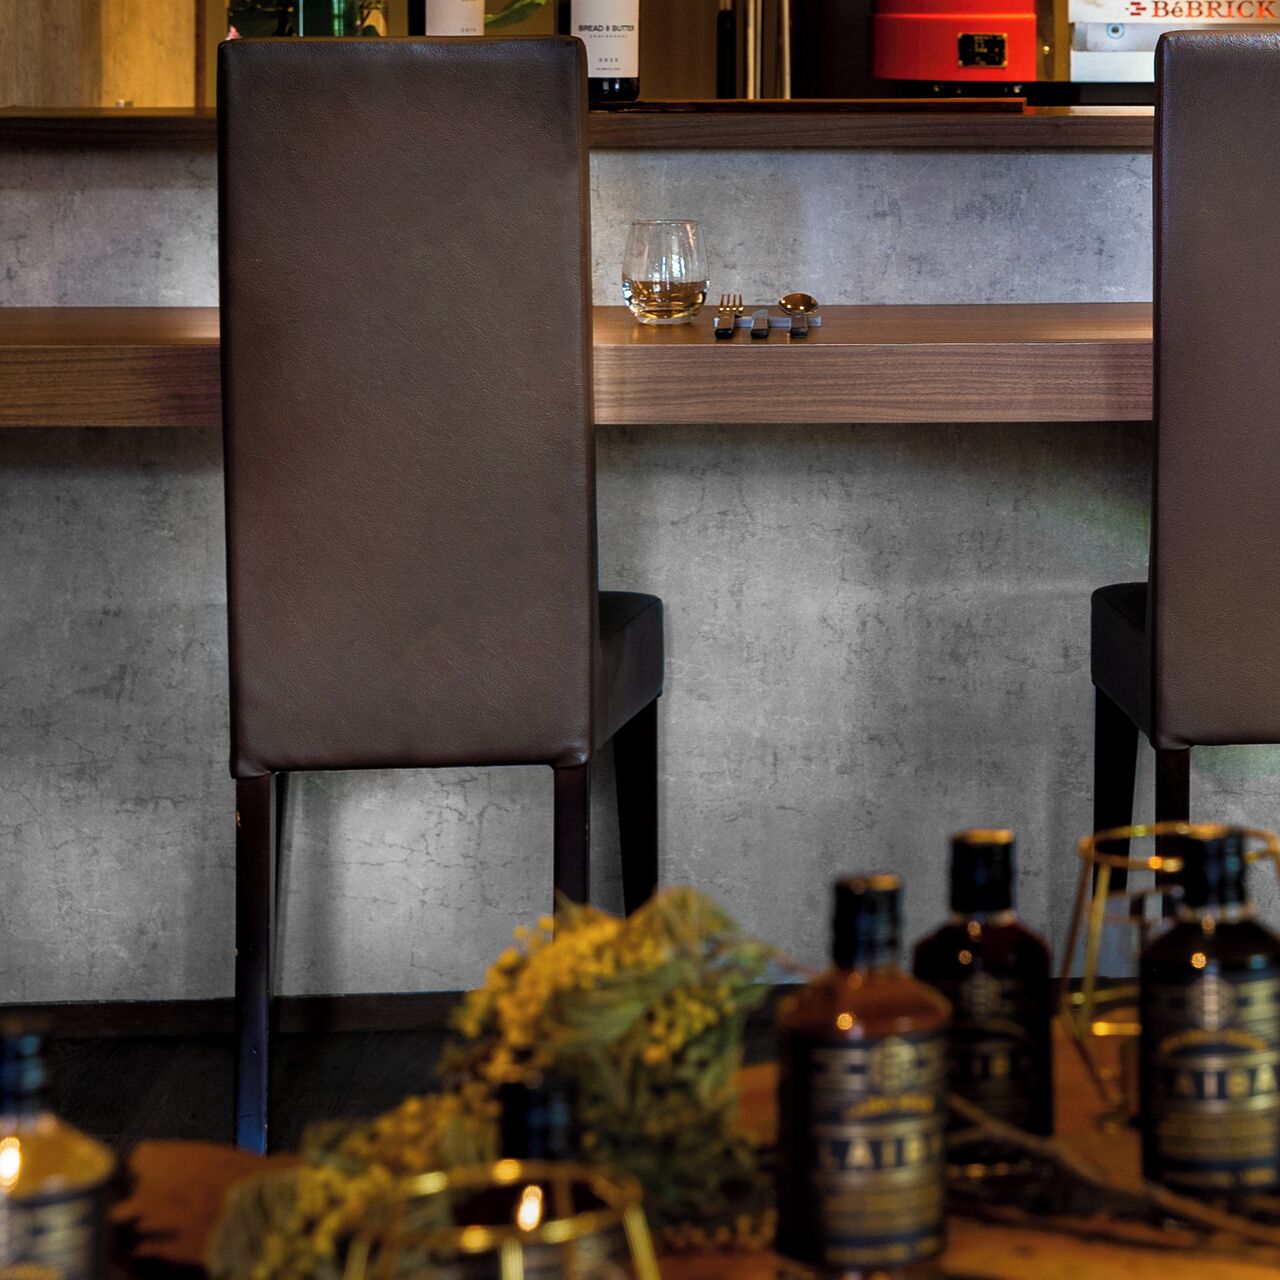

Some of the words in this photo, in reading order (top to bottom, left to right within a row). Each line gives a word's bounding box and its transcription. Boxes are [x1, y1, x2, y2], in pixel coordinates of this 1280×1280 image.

[1151, 0, 1278, 19] BéBRICK
[578, 24, 604, 32] BREAD
[612, 24, 634, 32] BUTTER
